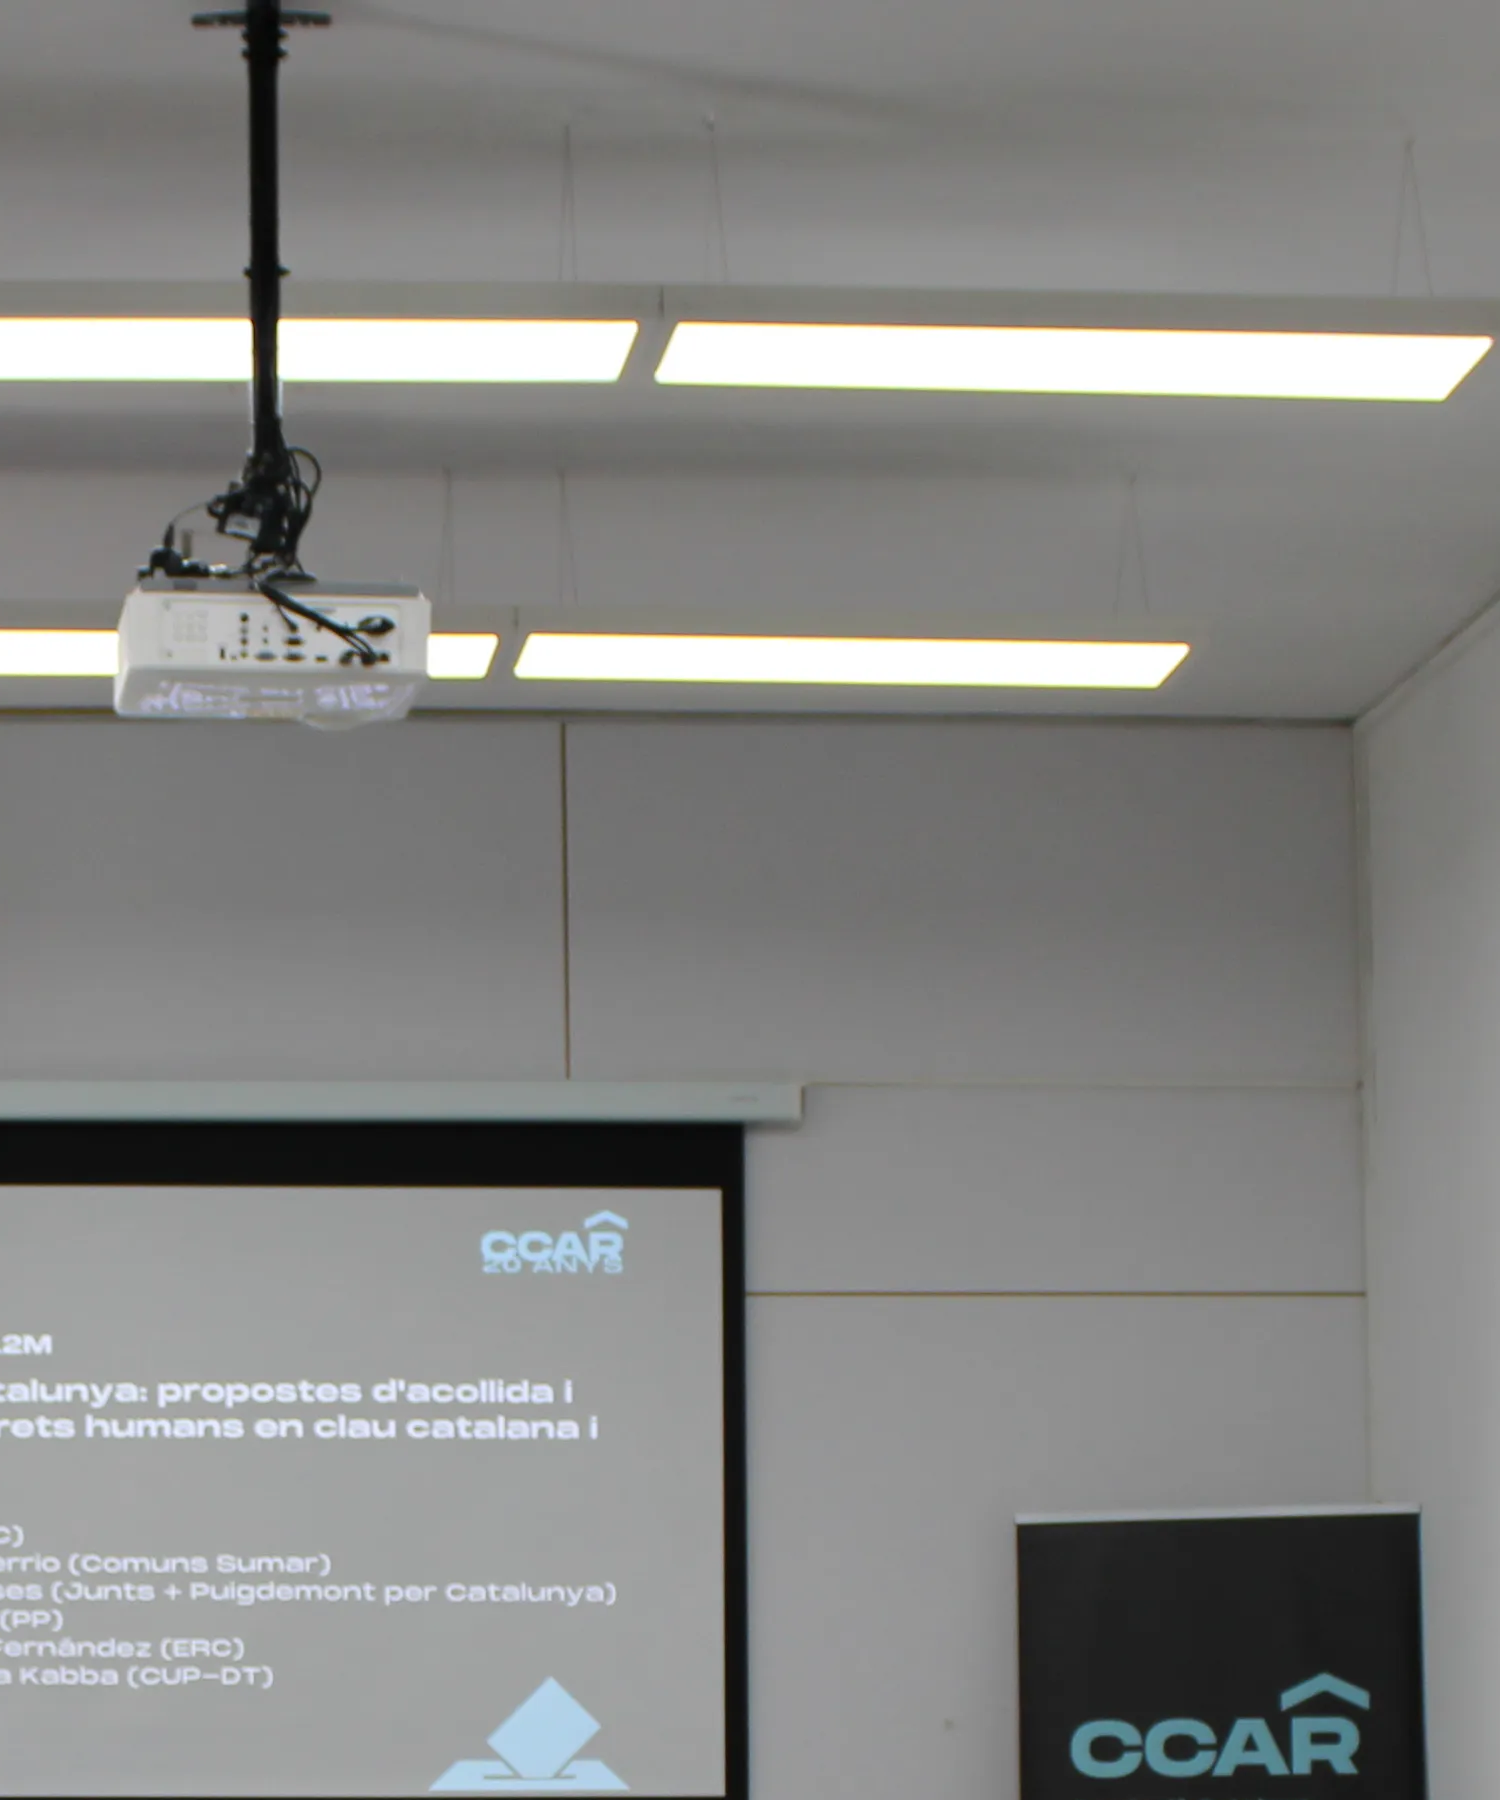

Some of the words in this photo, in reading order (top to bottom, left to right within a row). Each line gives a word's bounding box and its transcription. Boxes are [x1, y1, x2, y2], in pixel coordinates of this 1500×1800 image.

[480, 1230, 624, 1263] CCAR
[482, 1255, 522, 1274] 20
[532, 1255, 624, 1274] ANYS
[156, 1379, 363, 1410] propostes
[370, 1377, 555, 1405] d'acollida
[562, 1378, 574, 1404] i
[84, 1413, 246, 1439] humans
[252, 1417, 305, 1440] en
[312, 1413, 397, 1440] clau
[404, 1414, 581, 1441] catalana
[588, 1414, 599, 1441] i
[67, 1552, 209, 1577] (Comuns
[215, 1552, 332, 1578] Sumar)
[50, 1580, 156, 1605] (Junts
[163, 1583, 183, 1601] +
[189, 1580, 377, 1605] Puigdemont
[383, 1584, 438, 1605] per
[443, 1581, 617, 1605] Catalunya)
[159, 1636, 245, 1662] (ERC)
[18, 1665, 120, 1686] Kabba
[1070, 1716, 1360, 1779] CCAR
